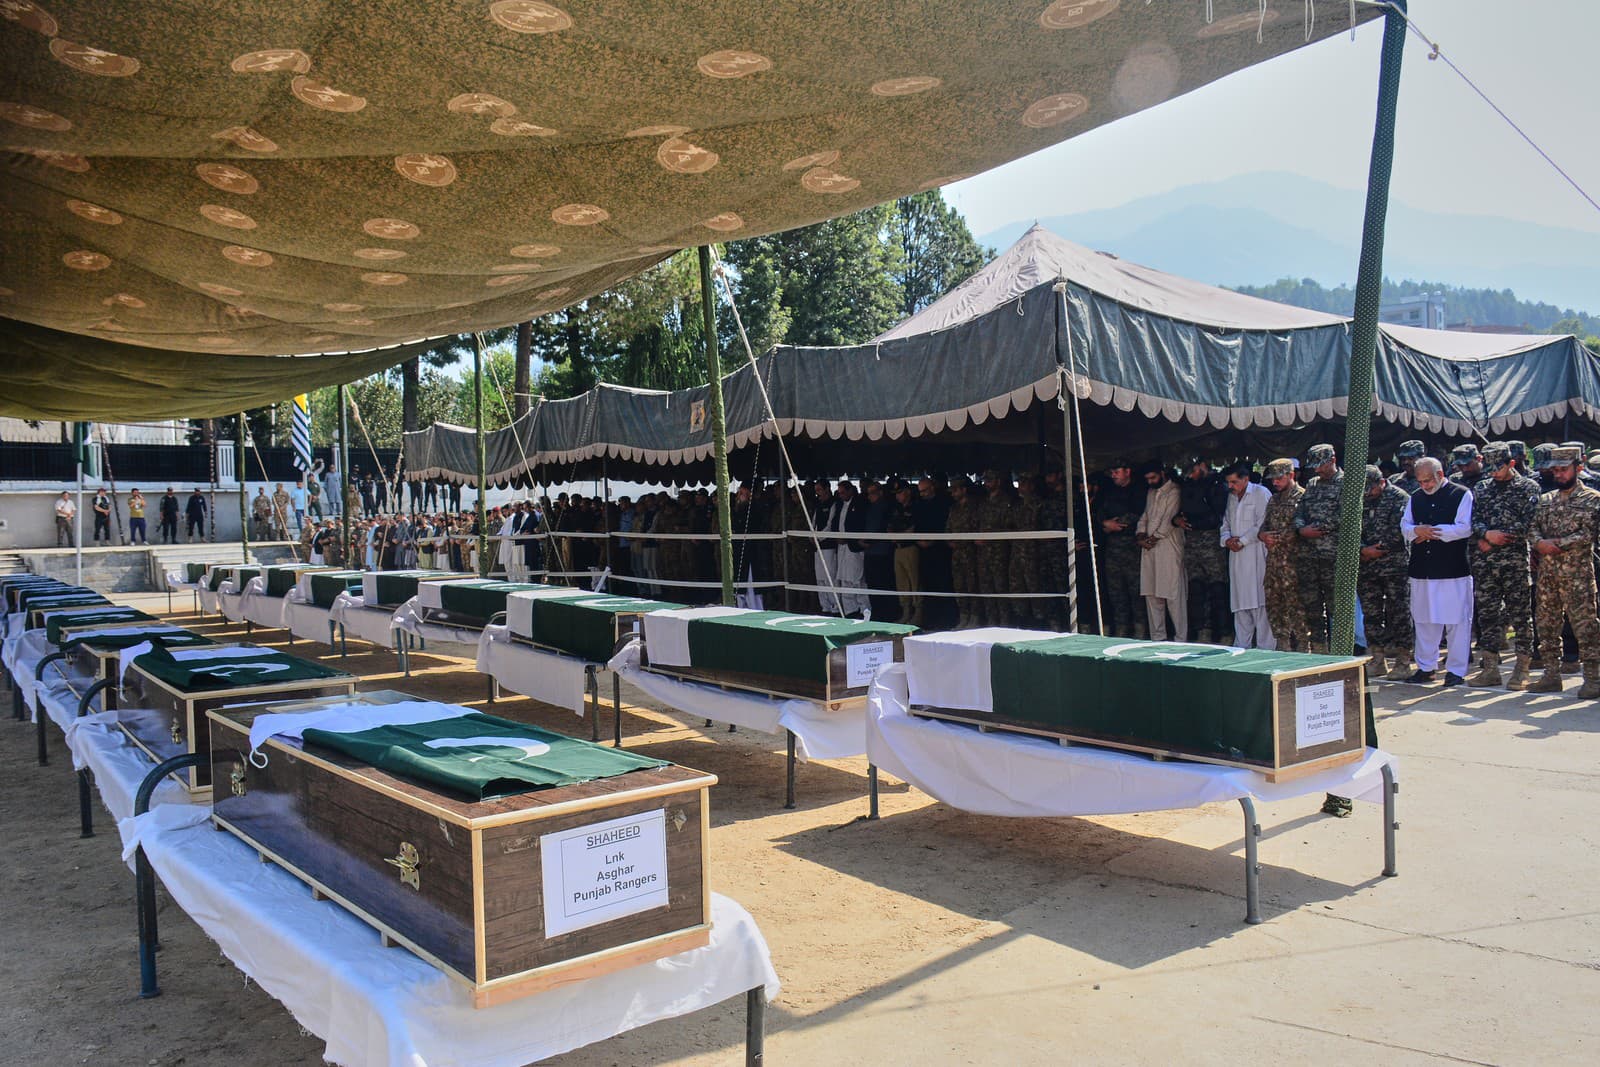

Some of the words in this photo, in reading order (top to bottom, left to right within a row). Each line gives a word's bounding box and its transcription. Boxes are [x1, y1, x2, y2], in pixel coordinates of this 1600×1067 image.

[1312, 688, 1334, 697] SHAHEED
[587, 825, 640, 848] SHAHEED
[605, 851, 624, 865] Lnk
[597, 864, 634, 882] Asghar
[574, 884, 611, 903] Punjab
[615, 873, 657, 892] Rangers
